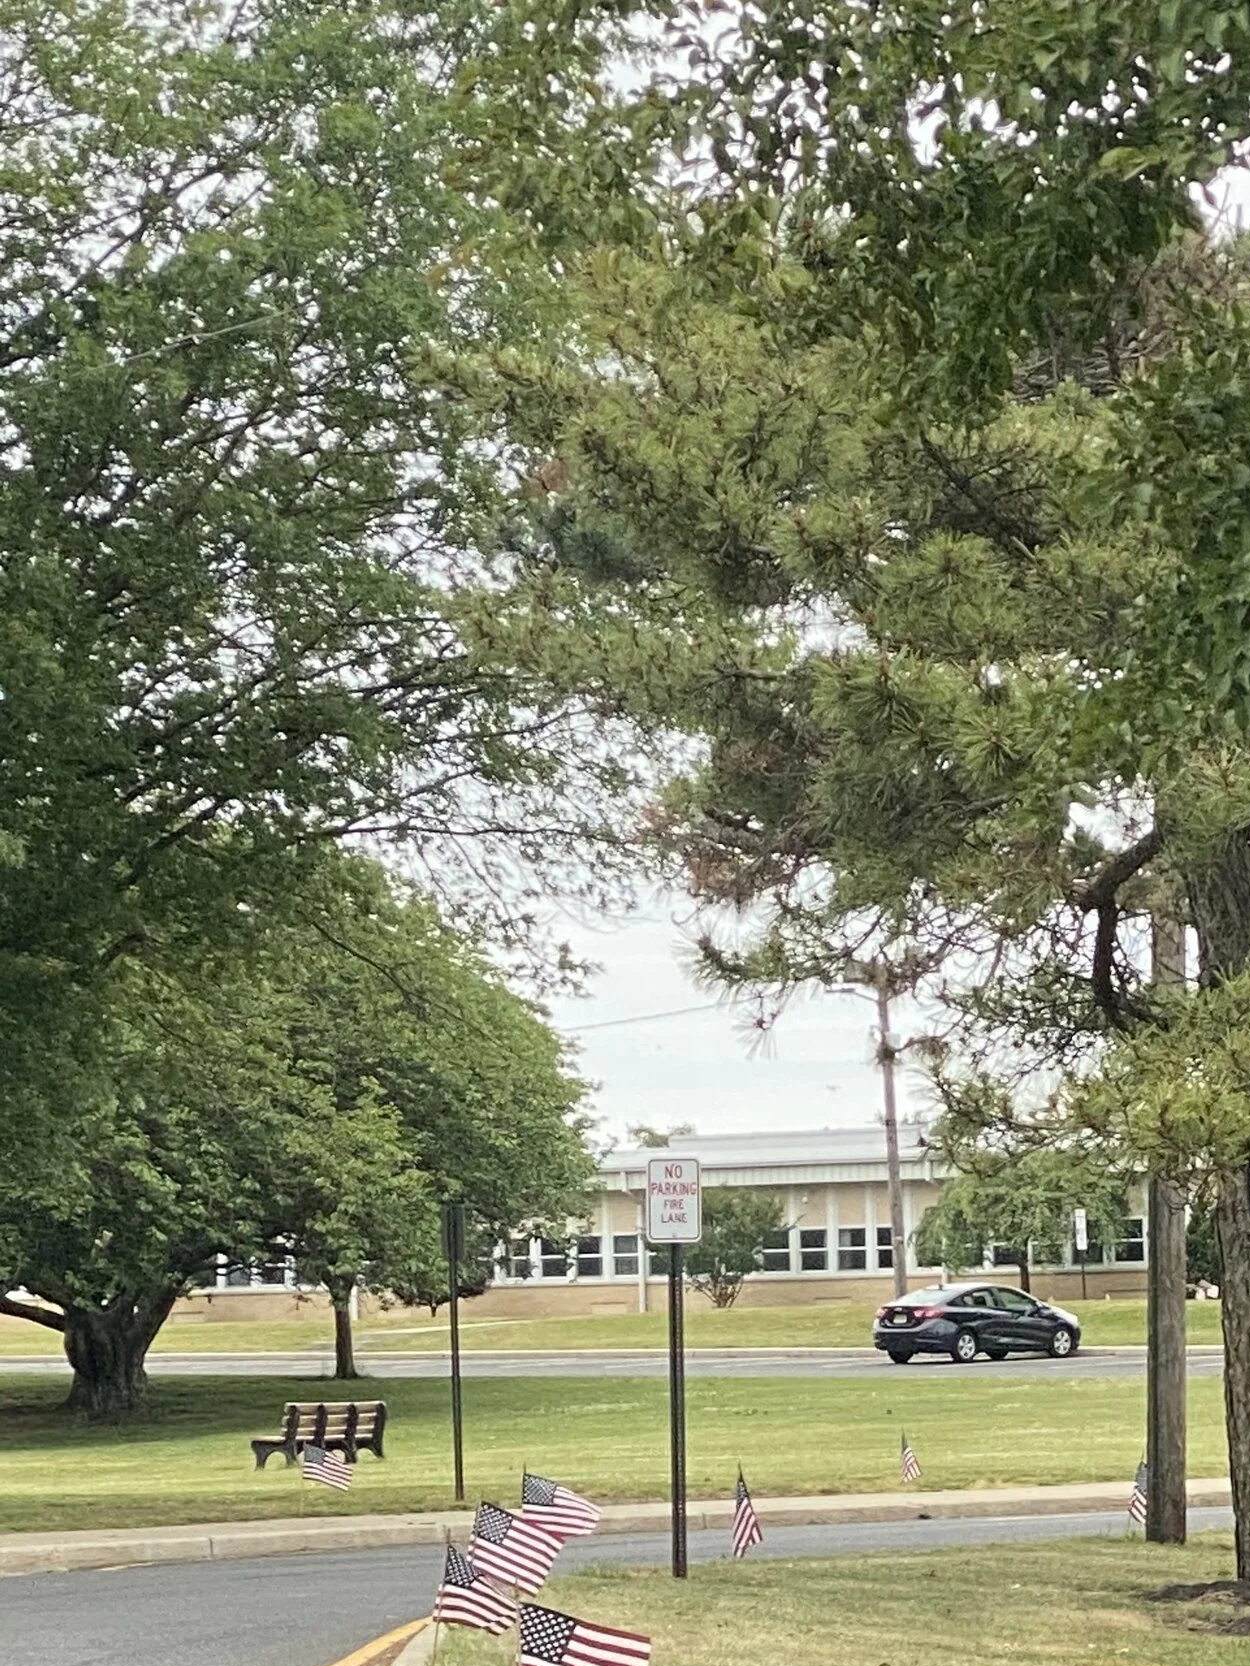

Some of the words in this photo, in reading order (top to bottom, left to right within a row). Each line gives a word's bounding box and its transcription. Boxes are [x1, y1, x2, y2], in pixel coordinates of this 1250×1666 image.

[664, 1164, 683, 1179] NO
[650, 1182, 697, 1195] PARKING
[664, 1199, 685, 1209] FIRE
[661, 1212, 688, 1223] LANE
